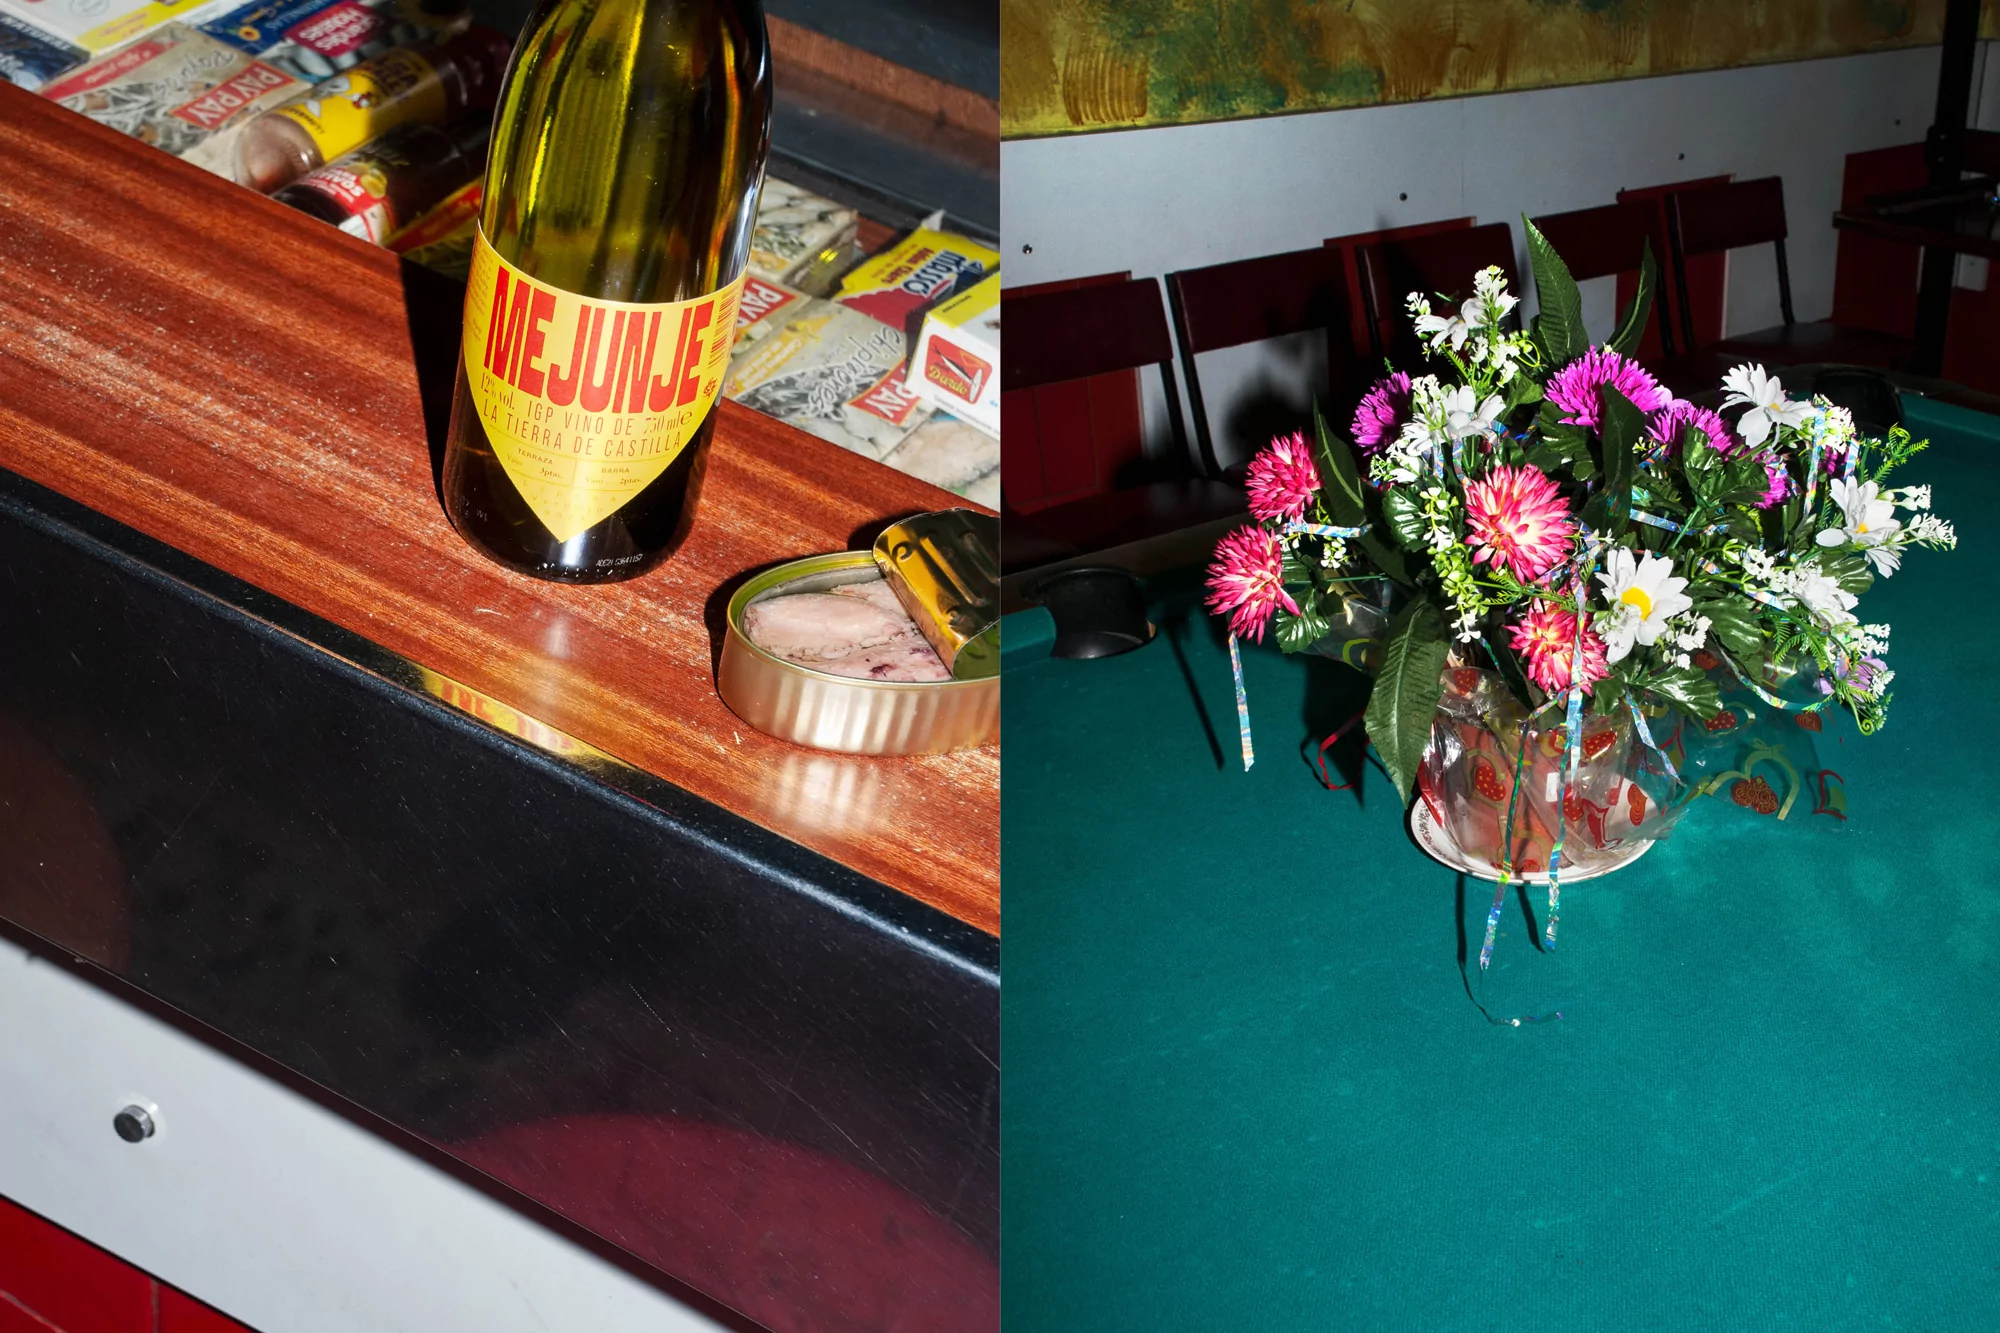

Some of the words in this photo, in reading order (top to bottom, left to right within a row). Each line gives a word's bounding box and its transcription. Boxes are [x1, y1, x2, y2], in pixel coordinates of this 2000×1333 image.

[230, 67, 283, 99] PAY
[187, 90, 244, 125] PAY
[484, 265, 715, 413] MEJUNJE
[808, 325, 901, 414] Chipirones
[928, 365, 968, 395] Dardo
[480, 371, 497, 399] 12%
[499, 392, 515, 410] vol.
[864, 378, 915, 418] PAY
[483, 399, 498, 423] LA
[506, 412, 562, 451] TIERRA
[573, 436, 595, 456] DE
[604, 431, 681, 457] CASTILLA
[528, 400, 554, 423] IGP
[564, 412, 604, 434] VINO
[614, 418, 633, 435] DE
[517, 448, 553, 465] TERRAZA
